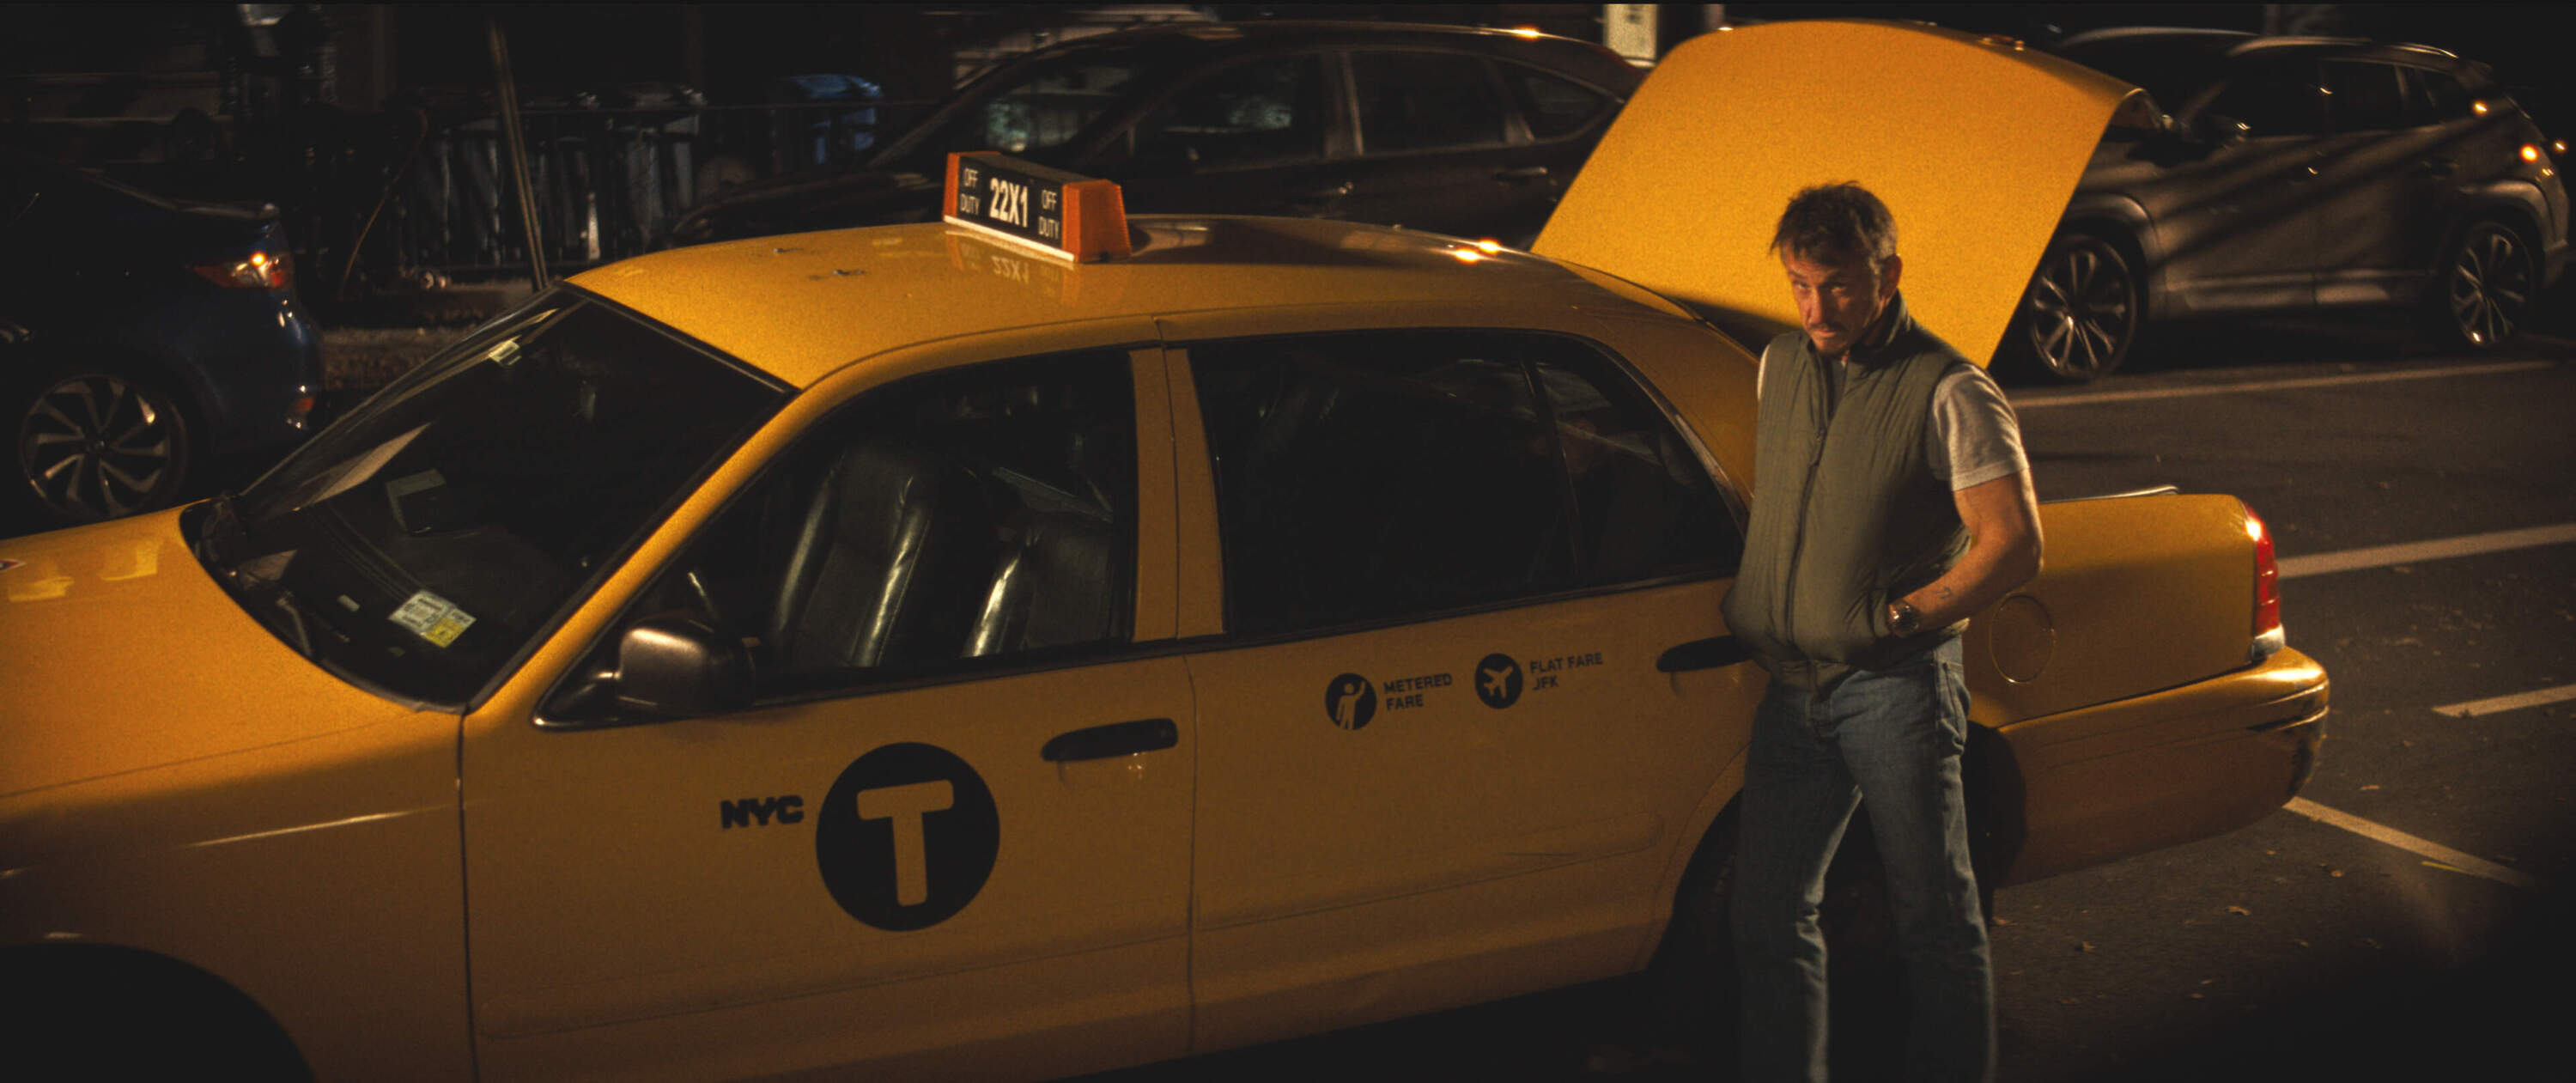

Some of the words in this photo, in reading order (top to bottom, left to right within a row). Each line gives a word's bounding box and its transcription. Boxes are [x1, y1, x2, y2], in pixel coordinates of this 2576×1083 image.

[963, 168, 978, 187] OFF
[960, 193, 980, 214] DUTY
[990, 178, 1028, 228] 22X1
[1042, 190, 1057, 210] OFF
[1038, 216, 1060, 240] DUTY
[1529, 657, 1563, 674] FLAT
[1566, 652, 1603, 669] FARE
[1383, 673, 1452, 694] METERED
[1532, 675, 1558, 691] JFK
[1386, 694, 1425, 711] FARE
[720, 794, 805, 830] NYC
[856, 779, 954, 907] T
